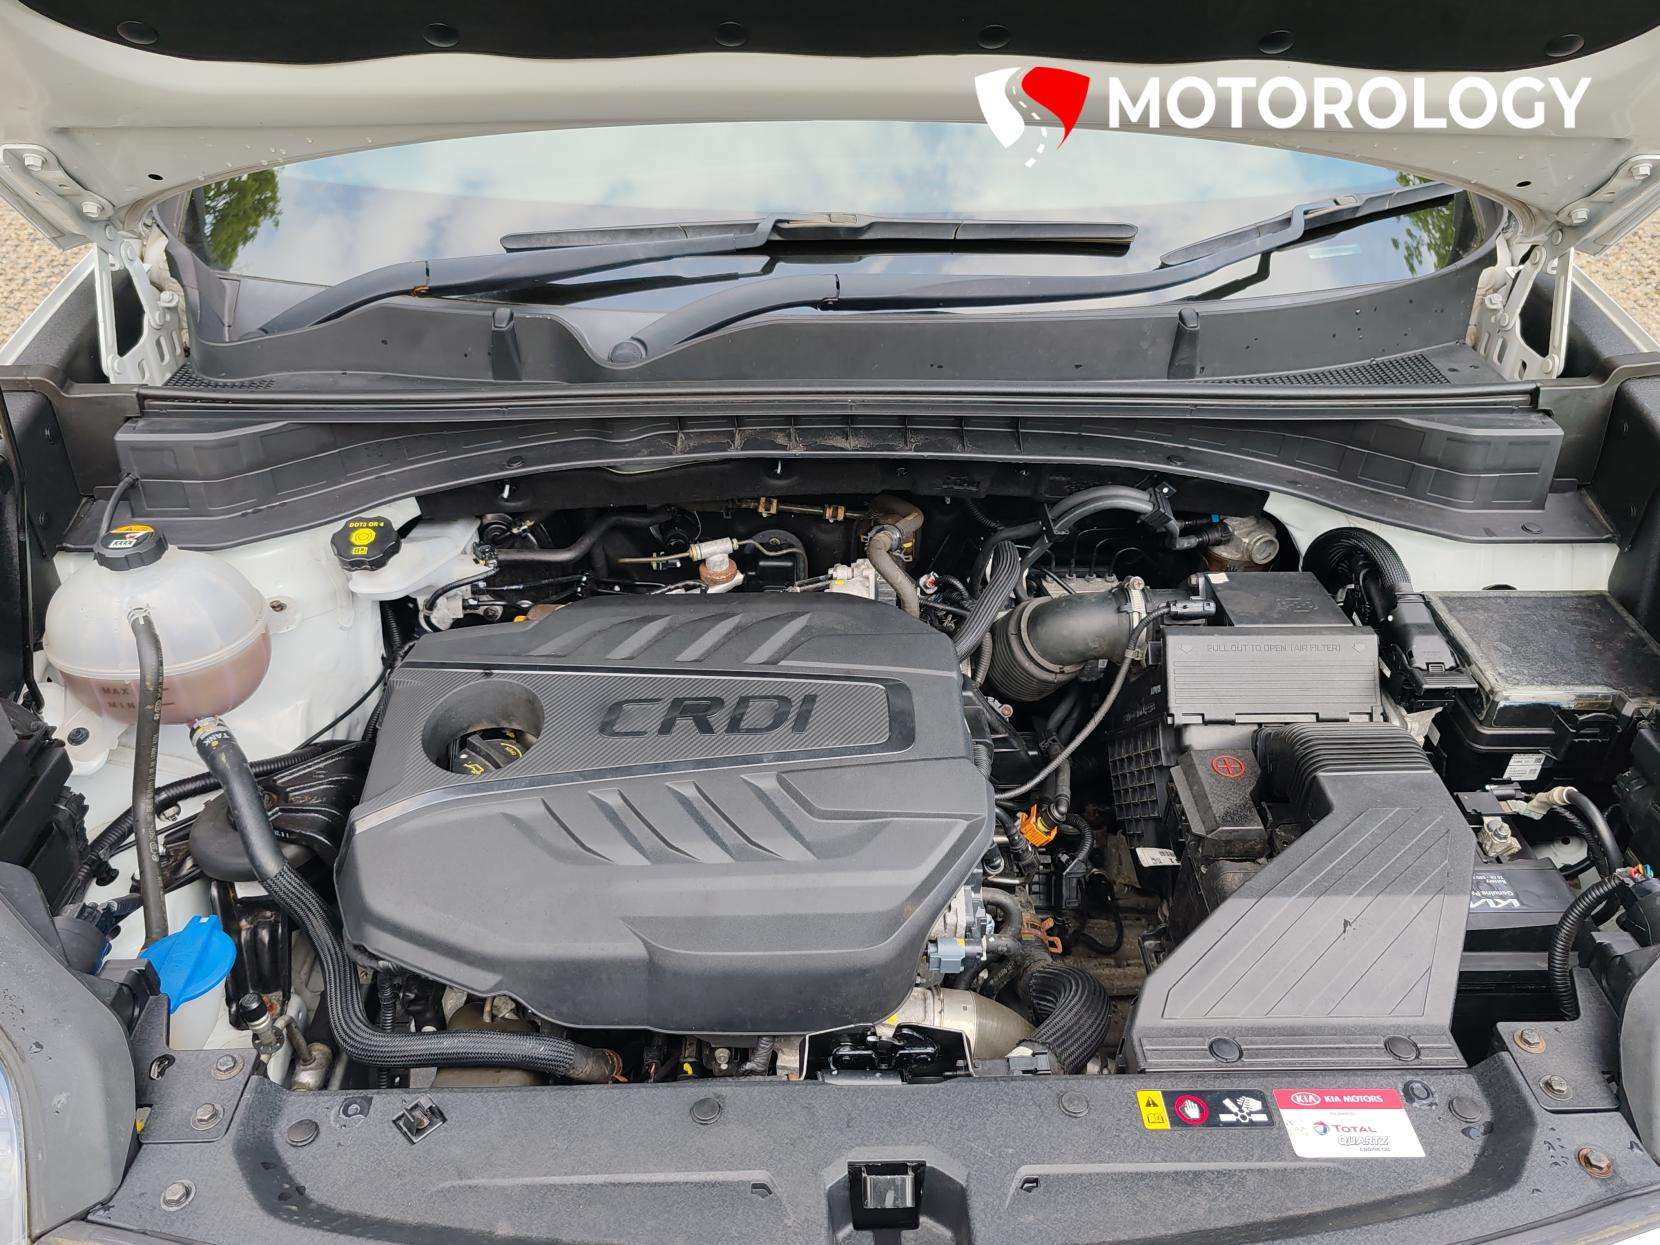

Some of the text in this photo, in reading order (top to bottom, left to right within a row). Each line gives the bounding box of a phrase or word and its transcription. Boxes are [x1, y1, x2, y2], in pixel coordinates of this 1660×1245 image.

[1207, 643, 1229, 652] PULL
[1230, 643, 1248, 652] OUT
[1251, 643, 1262, 652] TO
[1264, 643, 1287, 652] OPEN
[102, 687, 129, 695] MAX
[600, 694, 818, 738] CRDI
[1324, 1095, 1384, 1103] KIA MOTORS
[1331, 1124, 1377, 1133] TOTAL
[1337, 1136, 1389, 1147] QUARTZ
